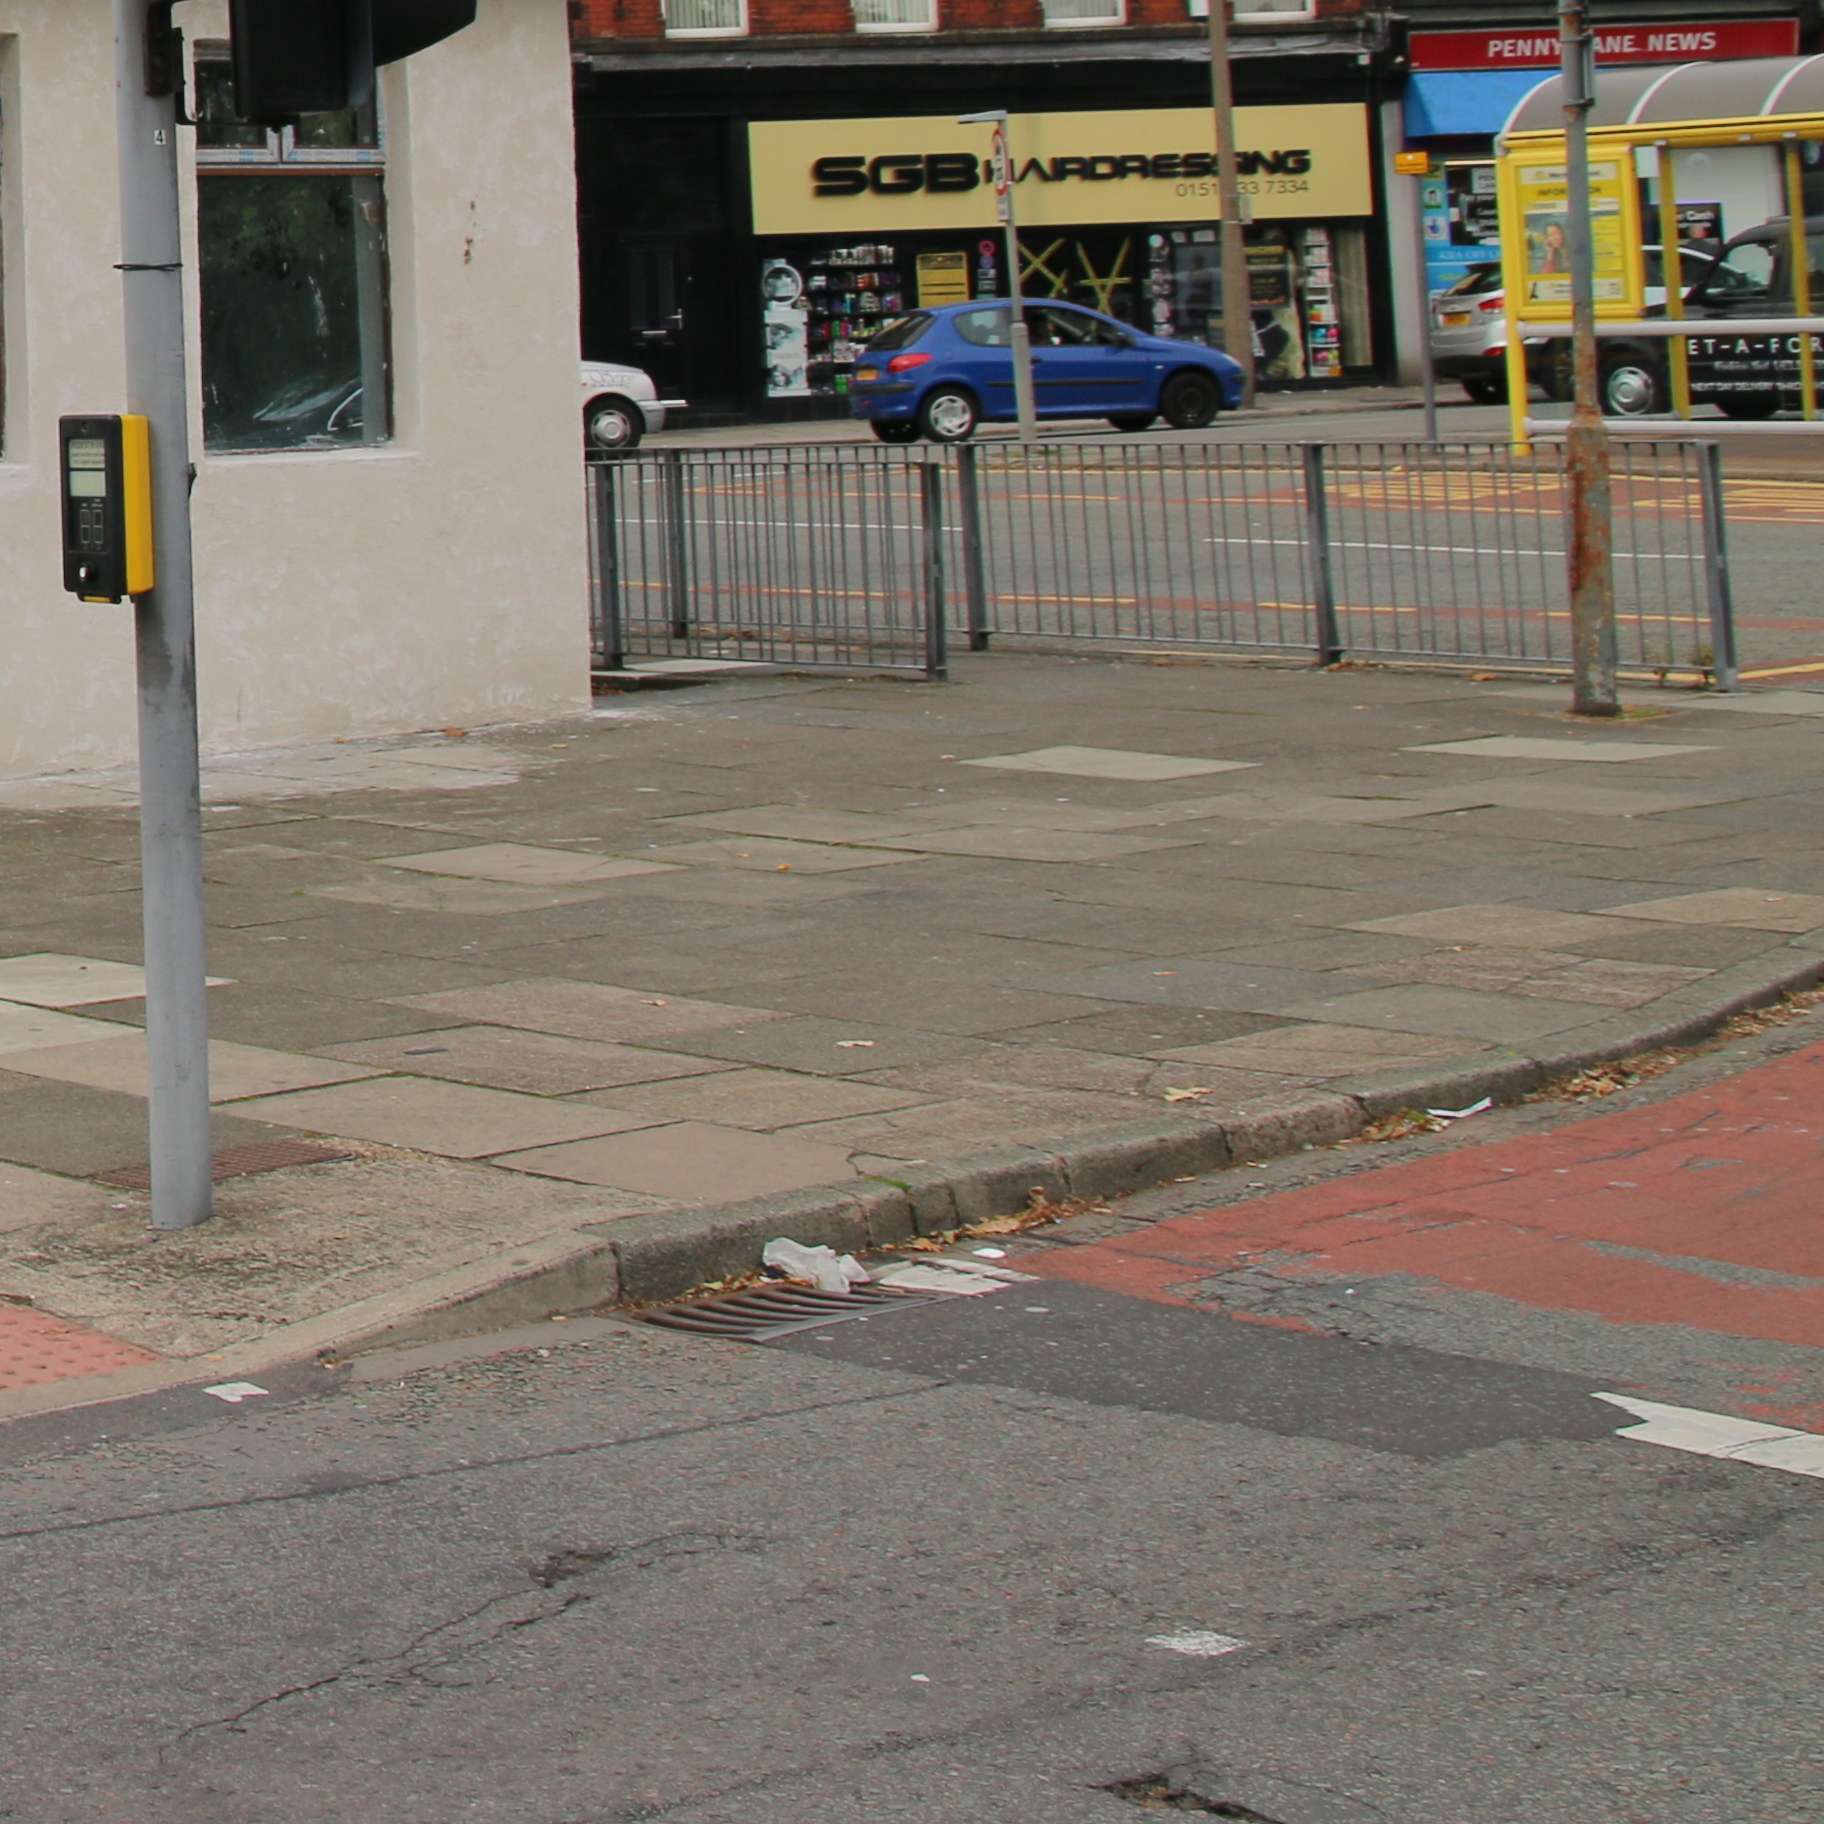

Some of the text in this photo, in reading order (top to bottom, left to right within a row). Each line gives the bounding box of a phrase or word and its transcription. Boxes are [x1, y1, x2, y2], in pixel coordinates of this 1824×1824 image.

[1488, 32, 1717, 58] PENNY ANE NEWS
[811, 152, 981, 197] SGB
[1176, 180, 1219, 198] 0151
[1265, 179, 1309, 195] 7334
